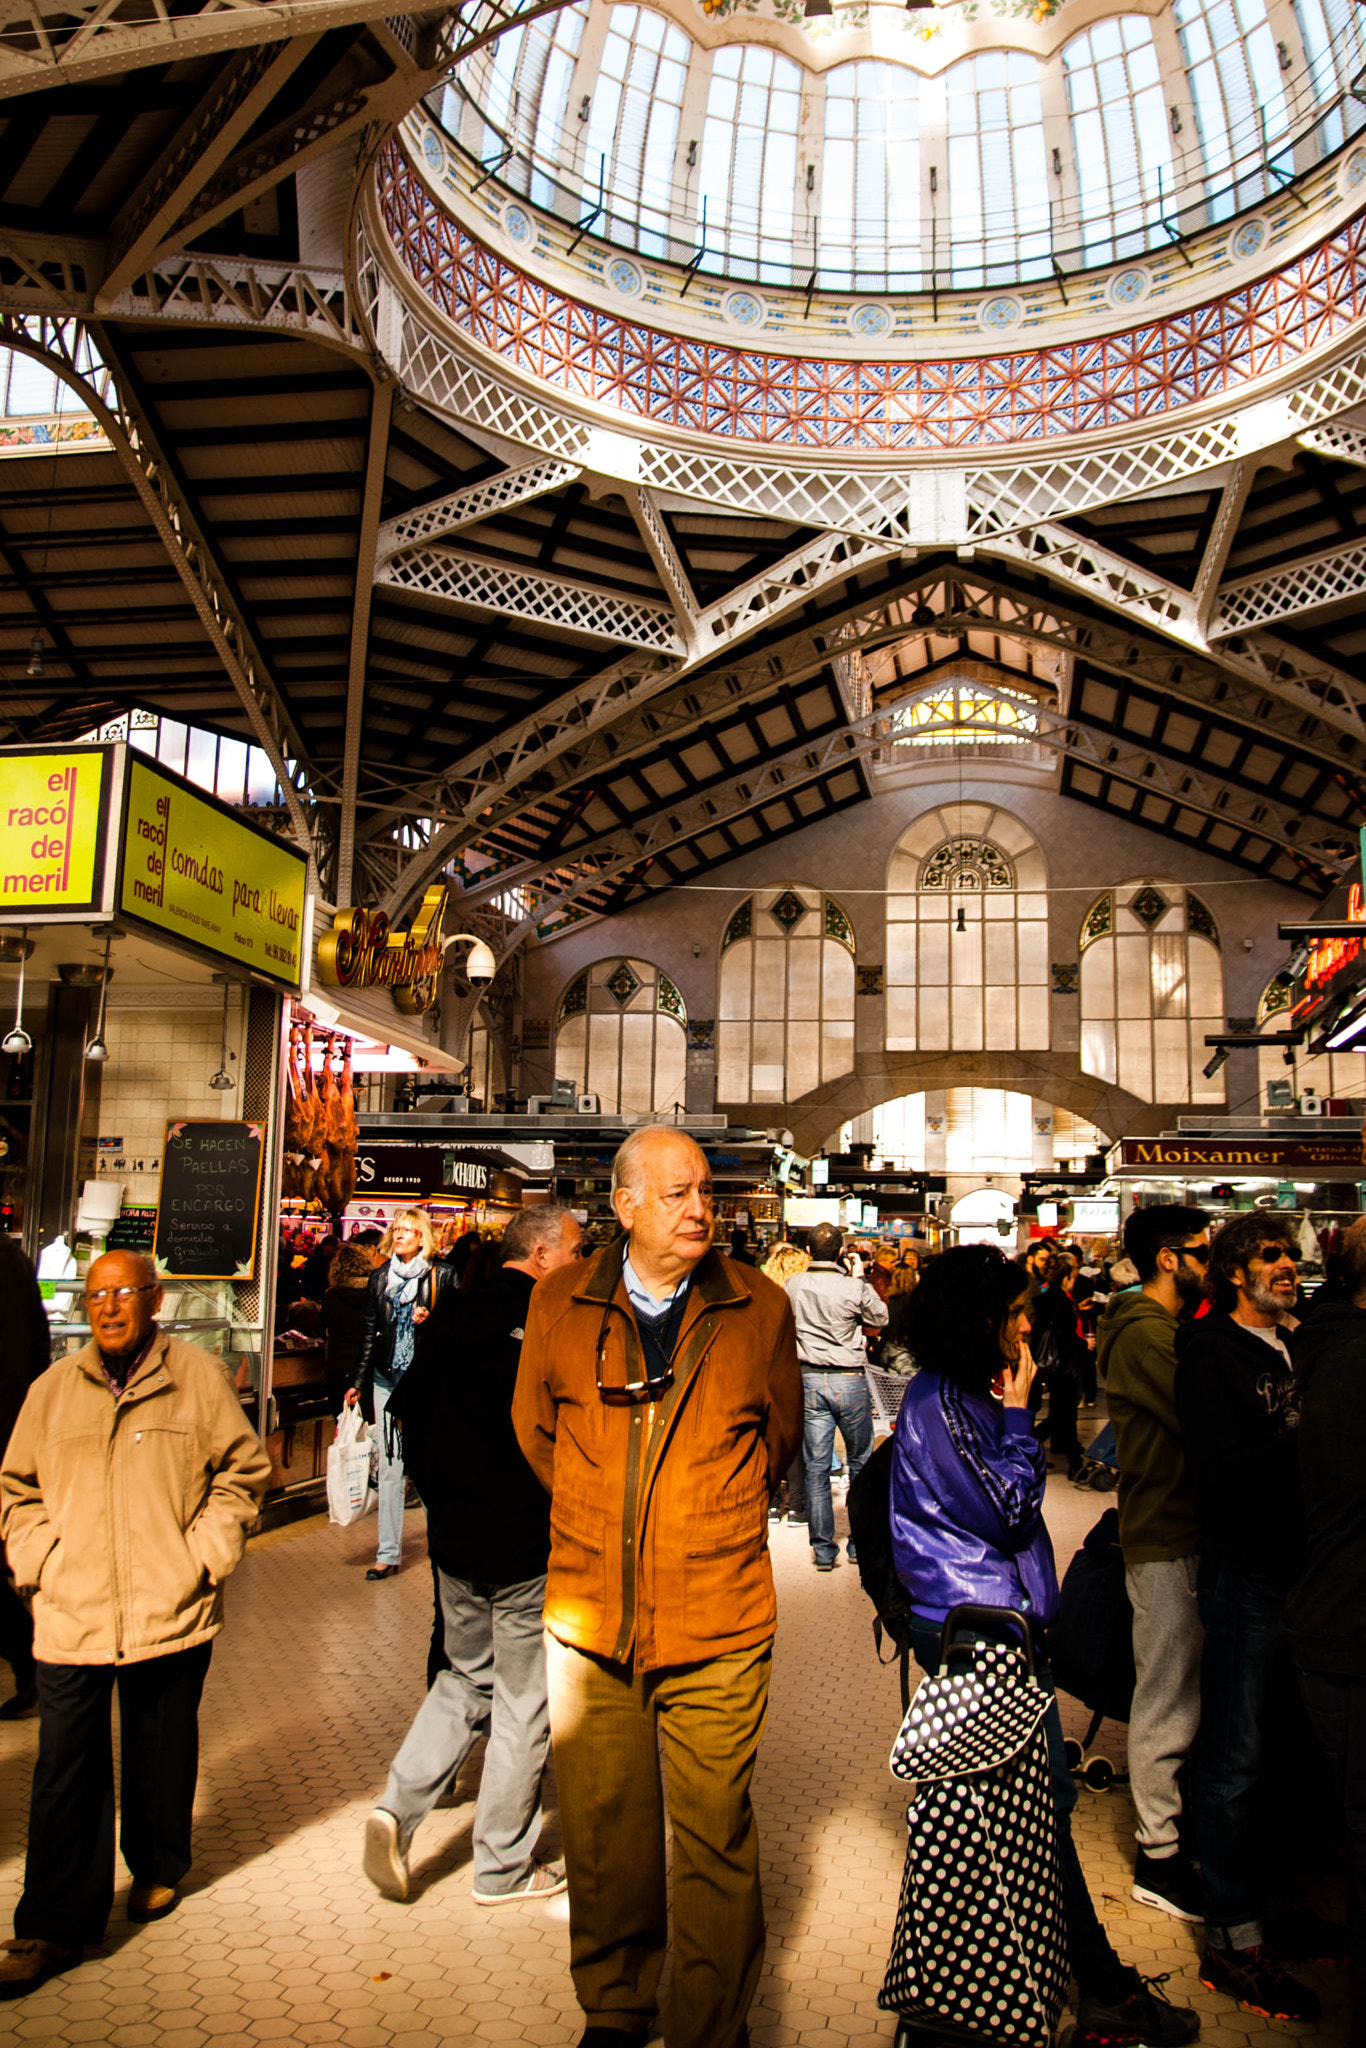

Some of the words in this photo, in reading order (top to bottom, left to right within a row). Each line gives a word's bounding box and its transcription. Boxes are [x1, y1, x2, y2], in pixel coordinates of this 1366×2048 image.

[48, 767, 71, 792] el
[7, 799, 67, 827] racó
[156, 796, 168, 818] el
[137, 817, 165, 846] racó
[31, 834, 65, 859] de
[147, 851, 163, 876] de
[171, 848, 224, 895] comidas
[232, 878, 261, 917] para
[268, 889, 300, 932] llevar
[168, 903, 188, 919] VALENCIA
[188, 911, 201, 926] FOOD
[172, 1135, 193, 1150] SE
[199, 1138, 246, 1152] HACEN
[1134, 1143, 1285, 1164] Moixamer
[180, 1156, 250, 1174] PAELLAS
[195, 1184, 225, 1197] POR
[383, 1176, 404, 1184] DESDE
[171, 1198, 245, 1213] ENCARGO
[169, 1217, 216, 1232] Servicio
[167, 1232, 215, 1244] domicilio
